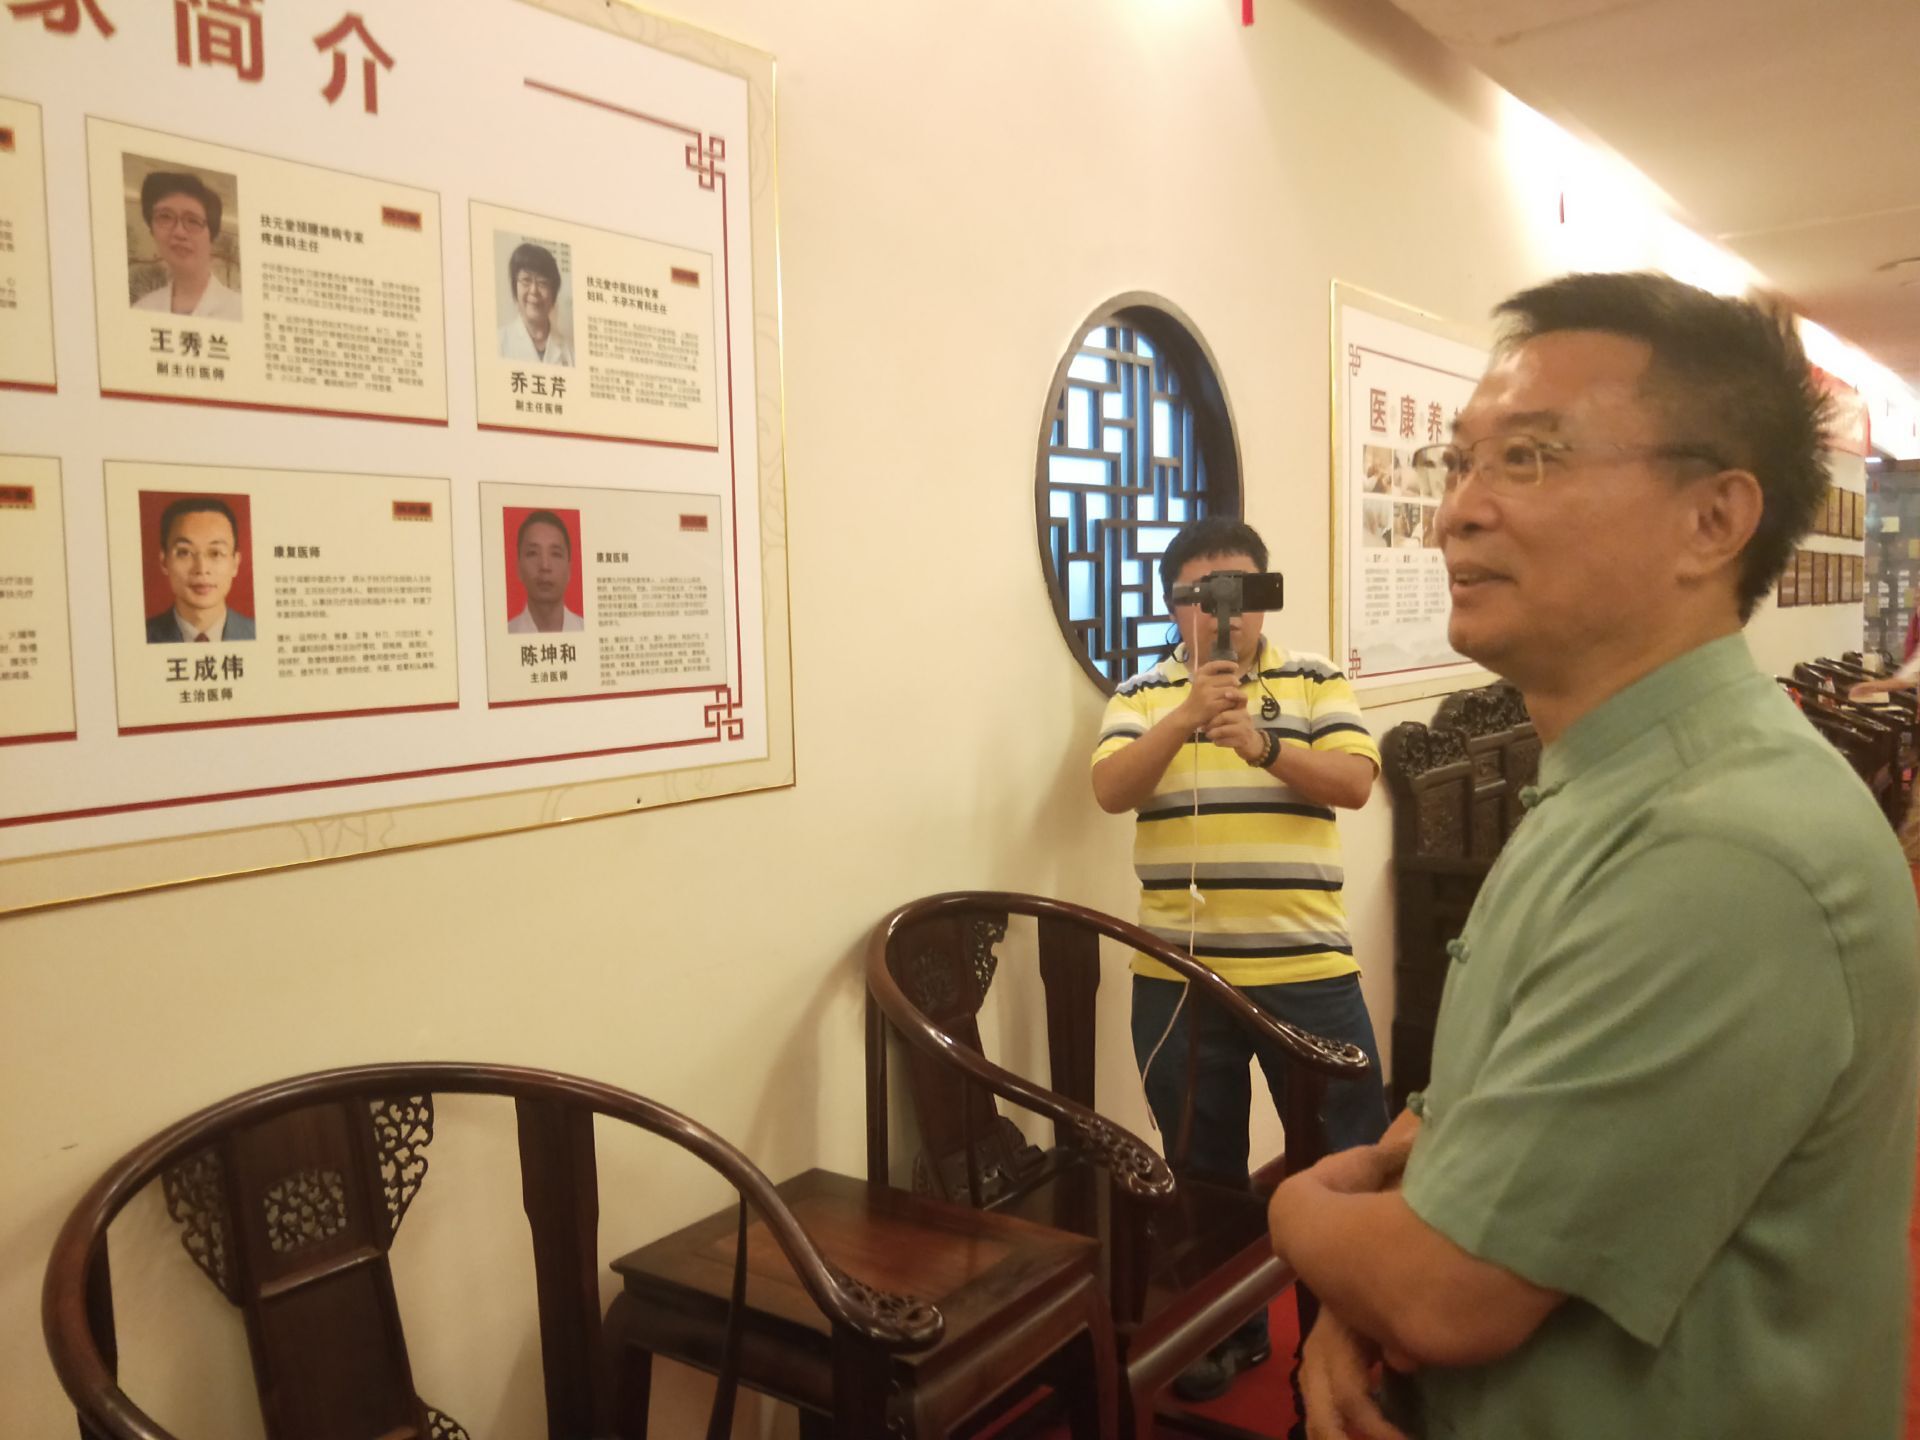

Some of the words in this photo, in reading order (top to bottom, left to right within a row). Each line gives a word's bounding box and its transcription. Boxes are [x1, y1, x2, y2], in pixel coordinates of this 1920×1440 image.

[261, 233, 319, 252] 疼痛科主任
[150, 328, 230, 360] 王秀兰
[156, 361, 225, 382] 副主任医师
[511, 371, 566, 399] 乔玉芹
[515, 400, 563, 415] 副主任医师
[1370, 388, 1466, 444] 医康养
[274, 546, 320, 559] 康复医师
[596, 552, 629, 563] 康复医师
[521, 643, 576, 667] 陈坤和
[166, 655, 244, 682] 王成伟
[530, 670, 568, 683] 主治医师
[179, 688, 233, 703] 主治医师
